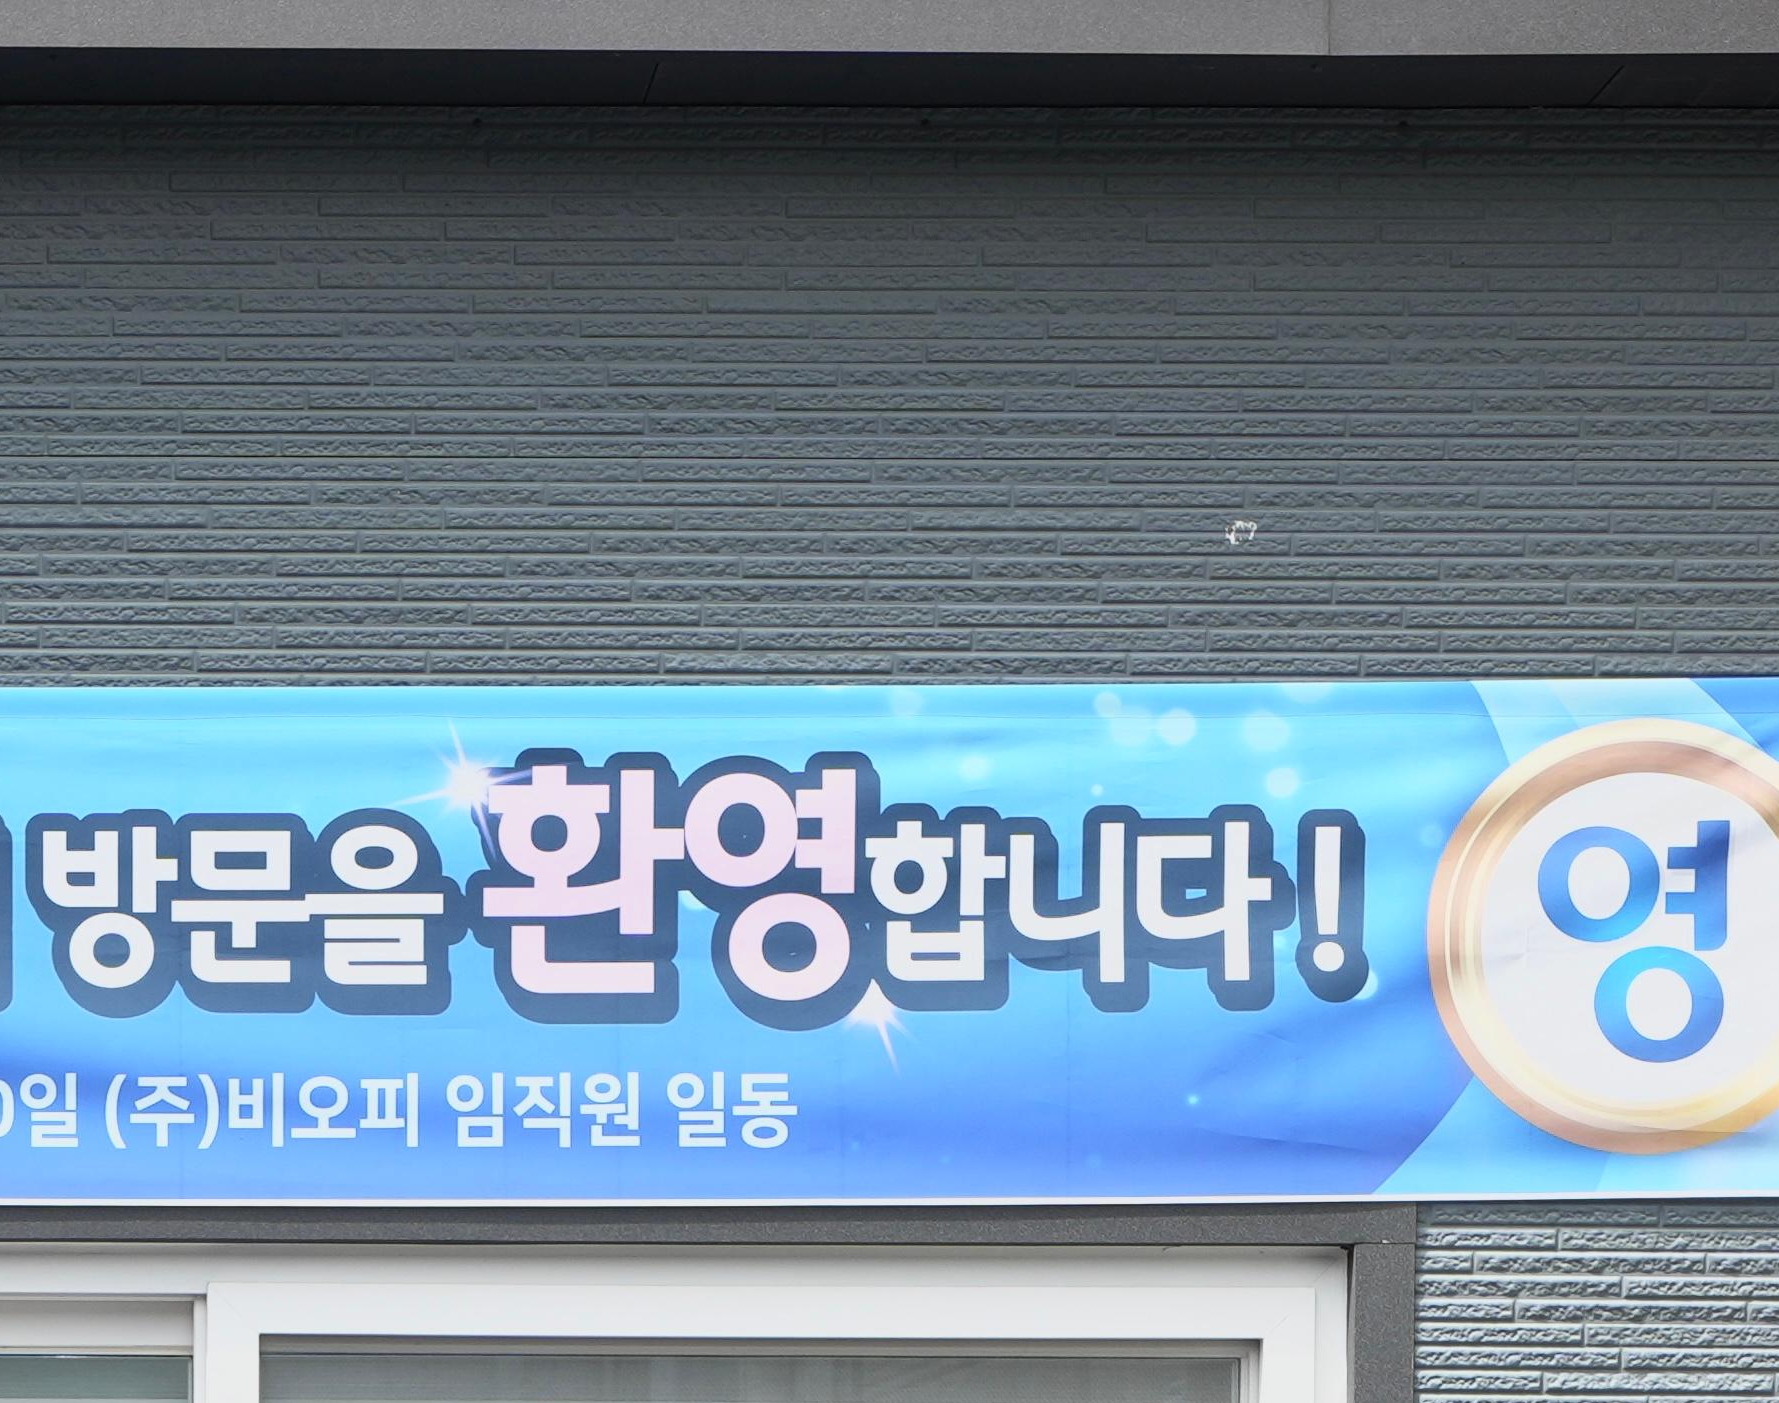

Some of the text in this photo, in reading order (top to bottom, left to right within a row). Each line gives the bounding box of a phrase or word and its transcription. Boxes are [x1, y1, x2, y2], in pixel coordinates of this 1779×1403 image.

[42, 824, 444, 989] 방문을
[1537, 818, 1732, 1063] 영
[105, 1071, 420, 1150] (주)비오피
[446, 1070, 642, 1149] 임직원
[665, 1070, 799, 1149] 일동
